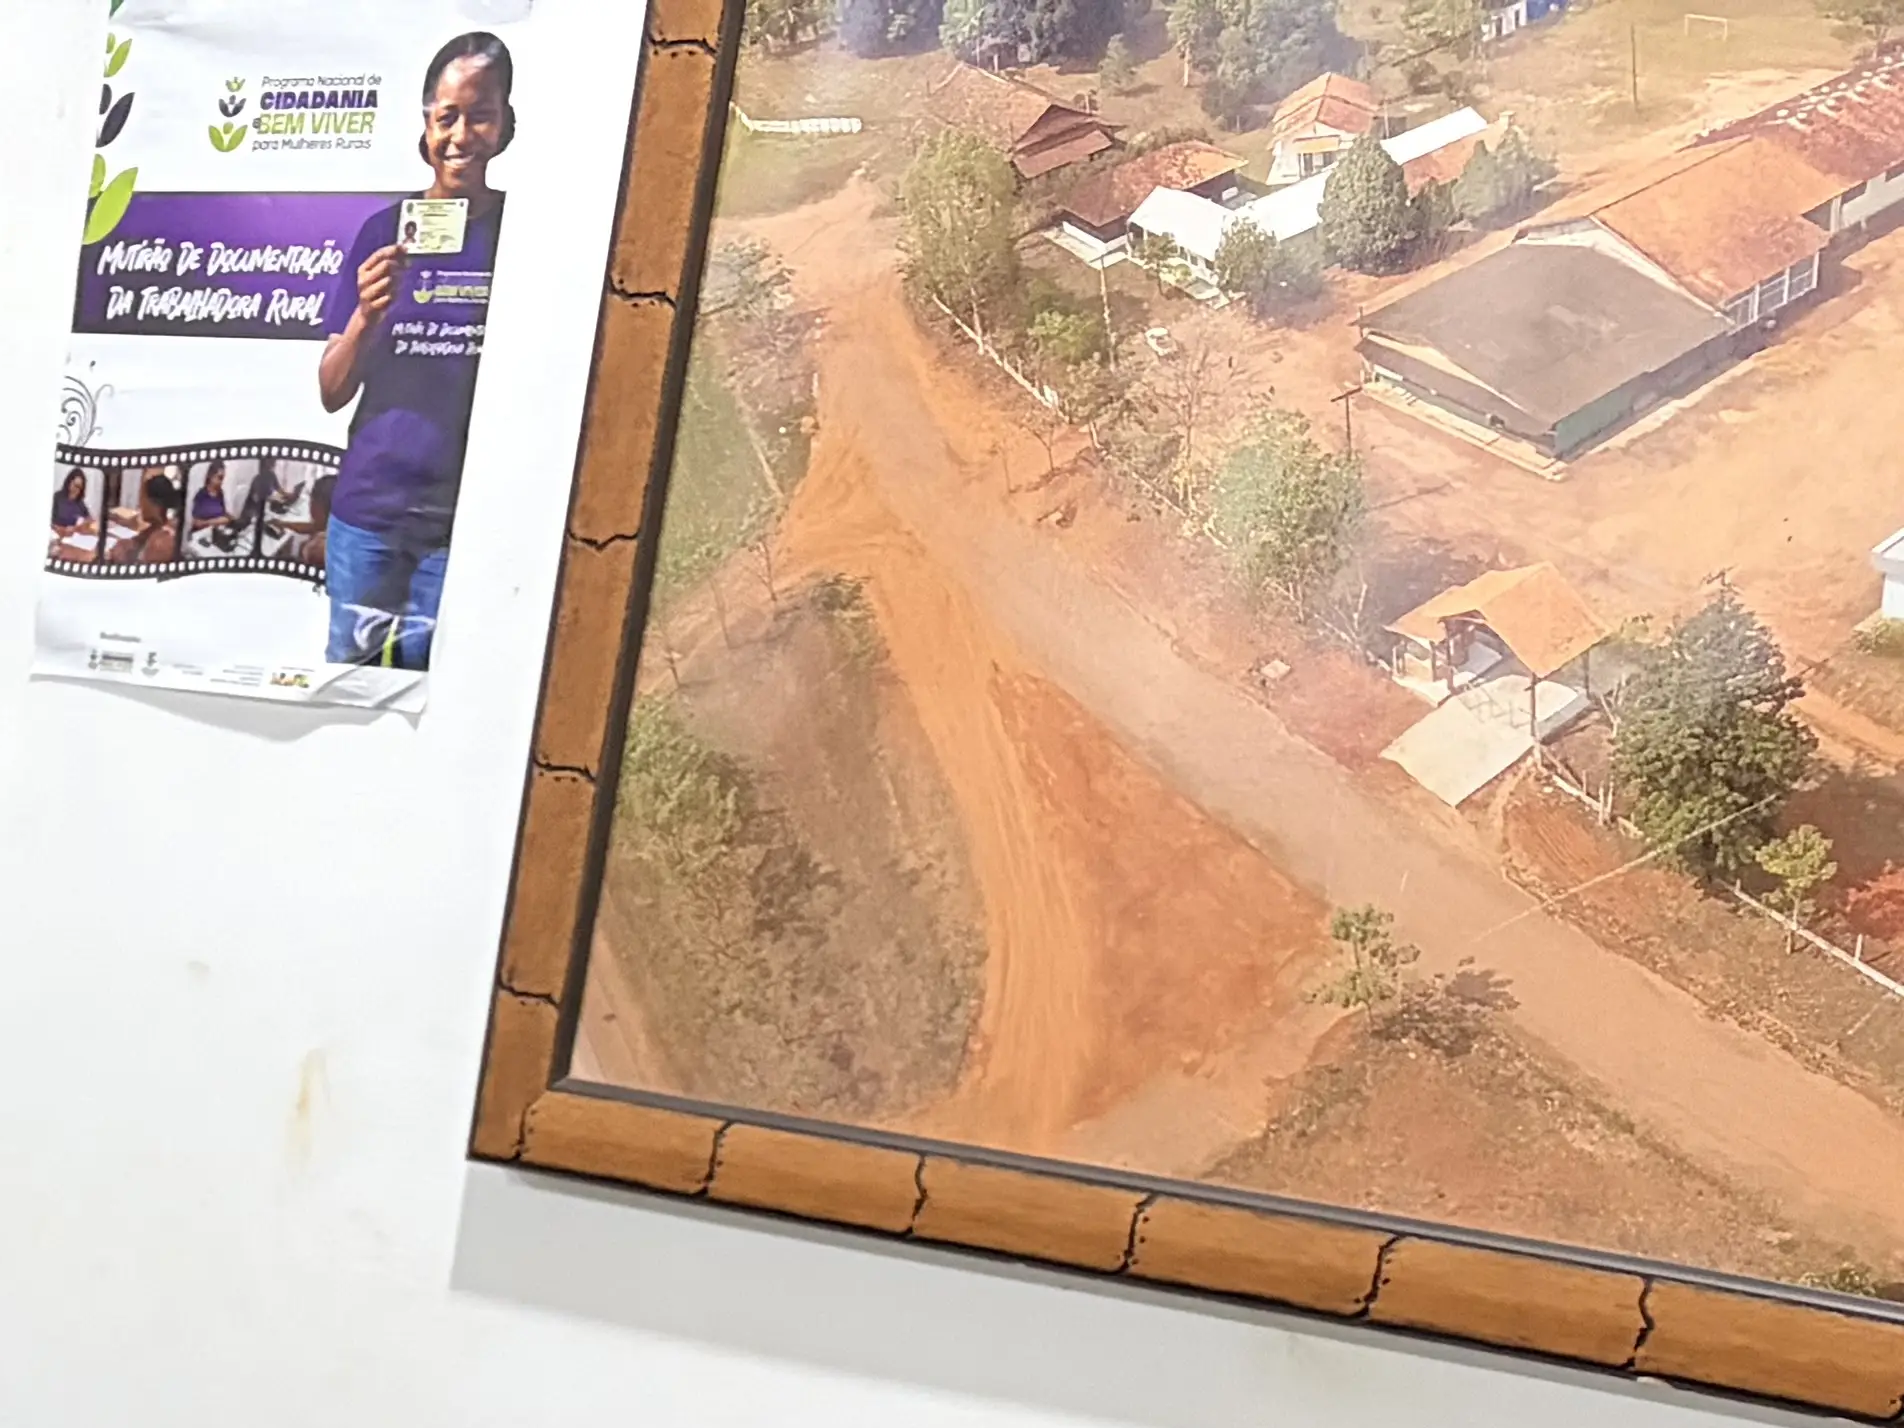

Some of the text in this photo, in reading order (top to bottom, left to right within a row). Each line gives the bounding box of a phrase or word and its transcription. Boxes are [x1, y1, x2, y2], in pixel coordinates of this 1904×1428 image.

[260, 90, 378, 110] CIDADANIA
[258, 112, 305, 134] BEM
[312, 111, 375, 134] VIVER
